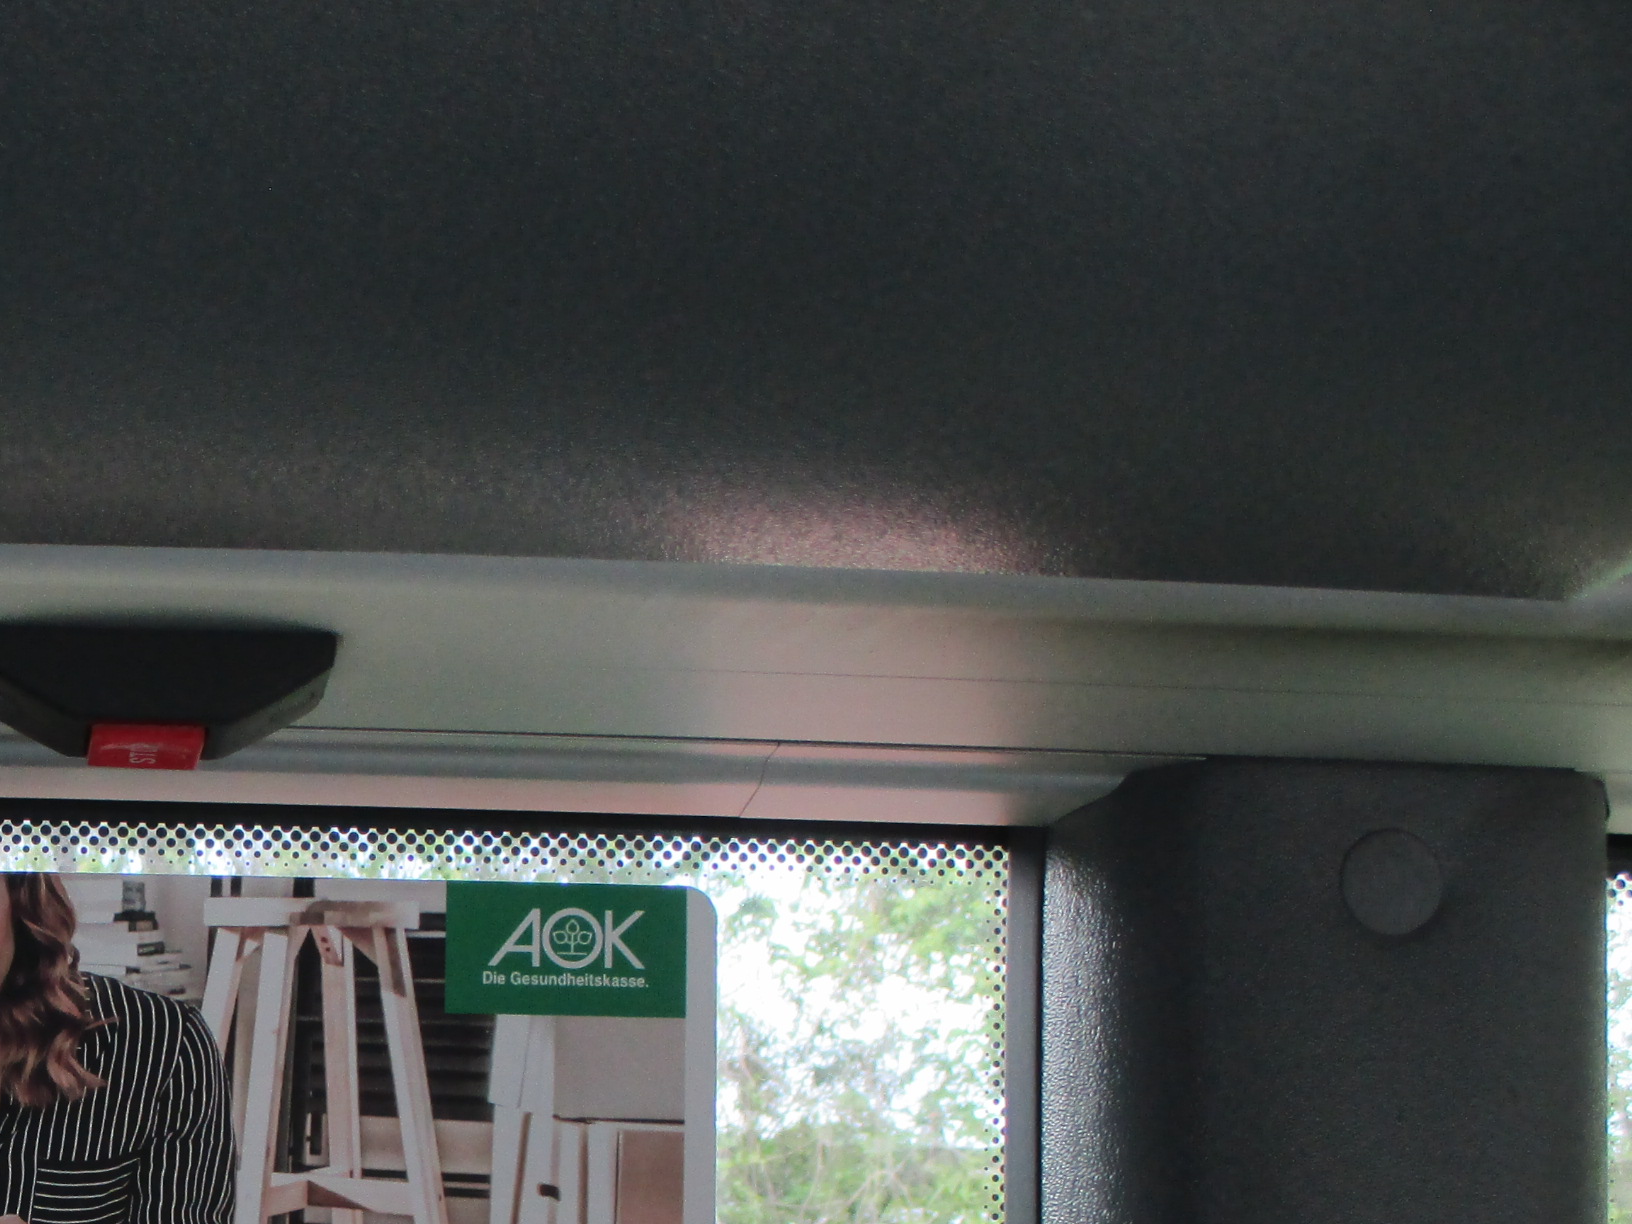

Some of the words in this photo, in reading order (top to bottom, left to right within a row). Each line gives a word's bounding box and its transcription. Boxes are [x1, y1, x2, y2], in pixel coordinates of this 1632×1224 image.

[487, 907, 646, 970] AOK
[482, 971, 506, 985] Die
[510, 971, 649, 989] Gesundheitskasse.
